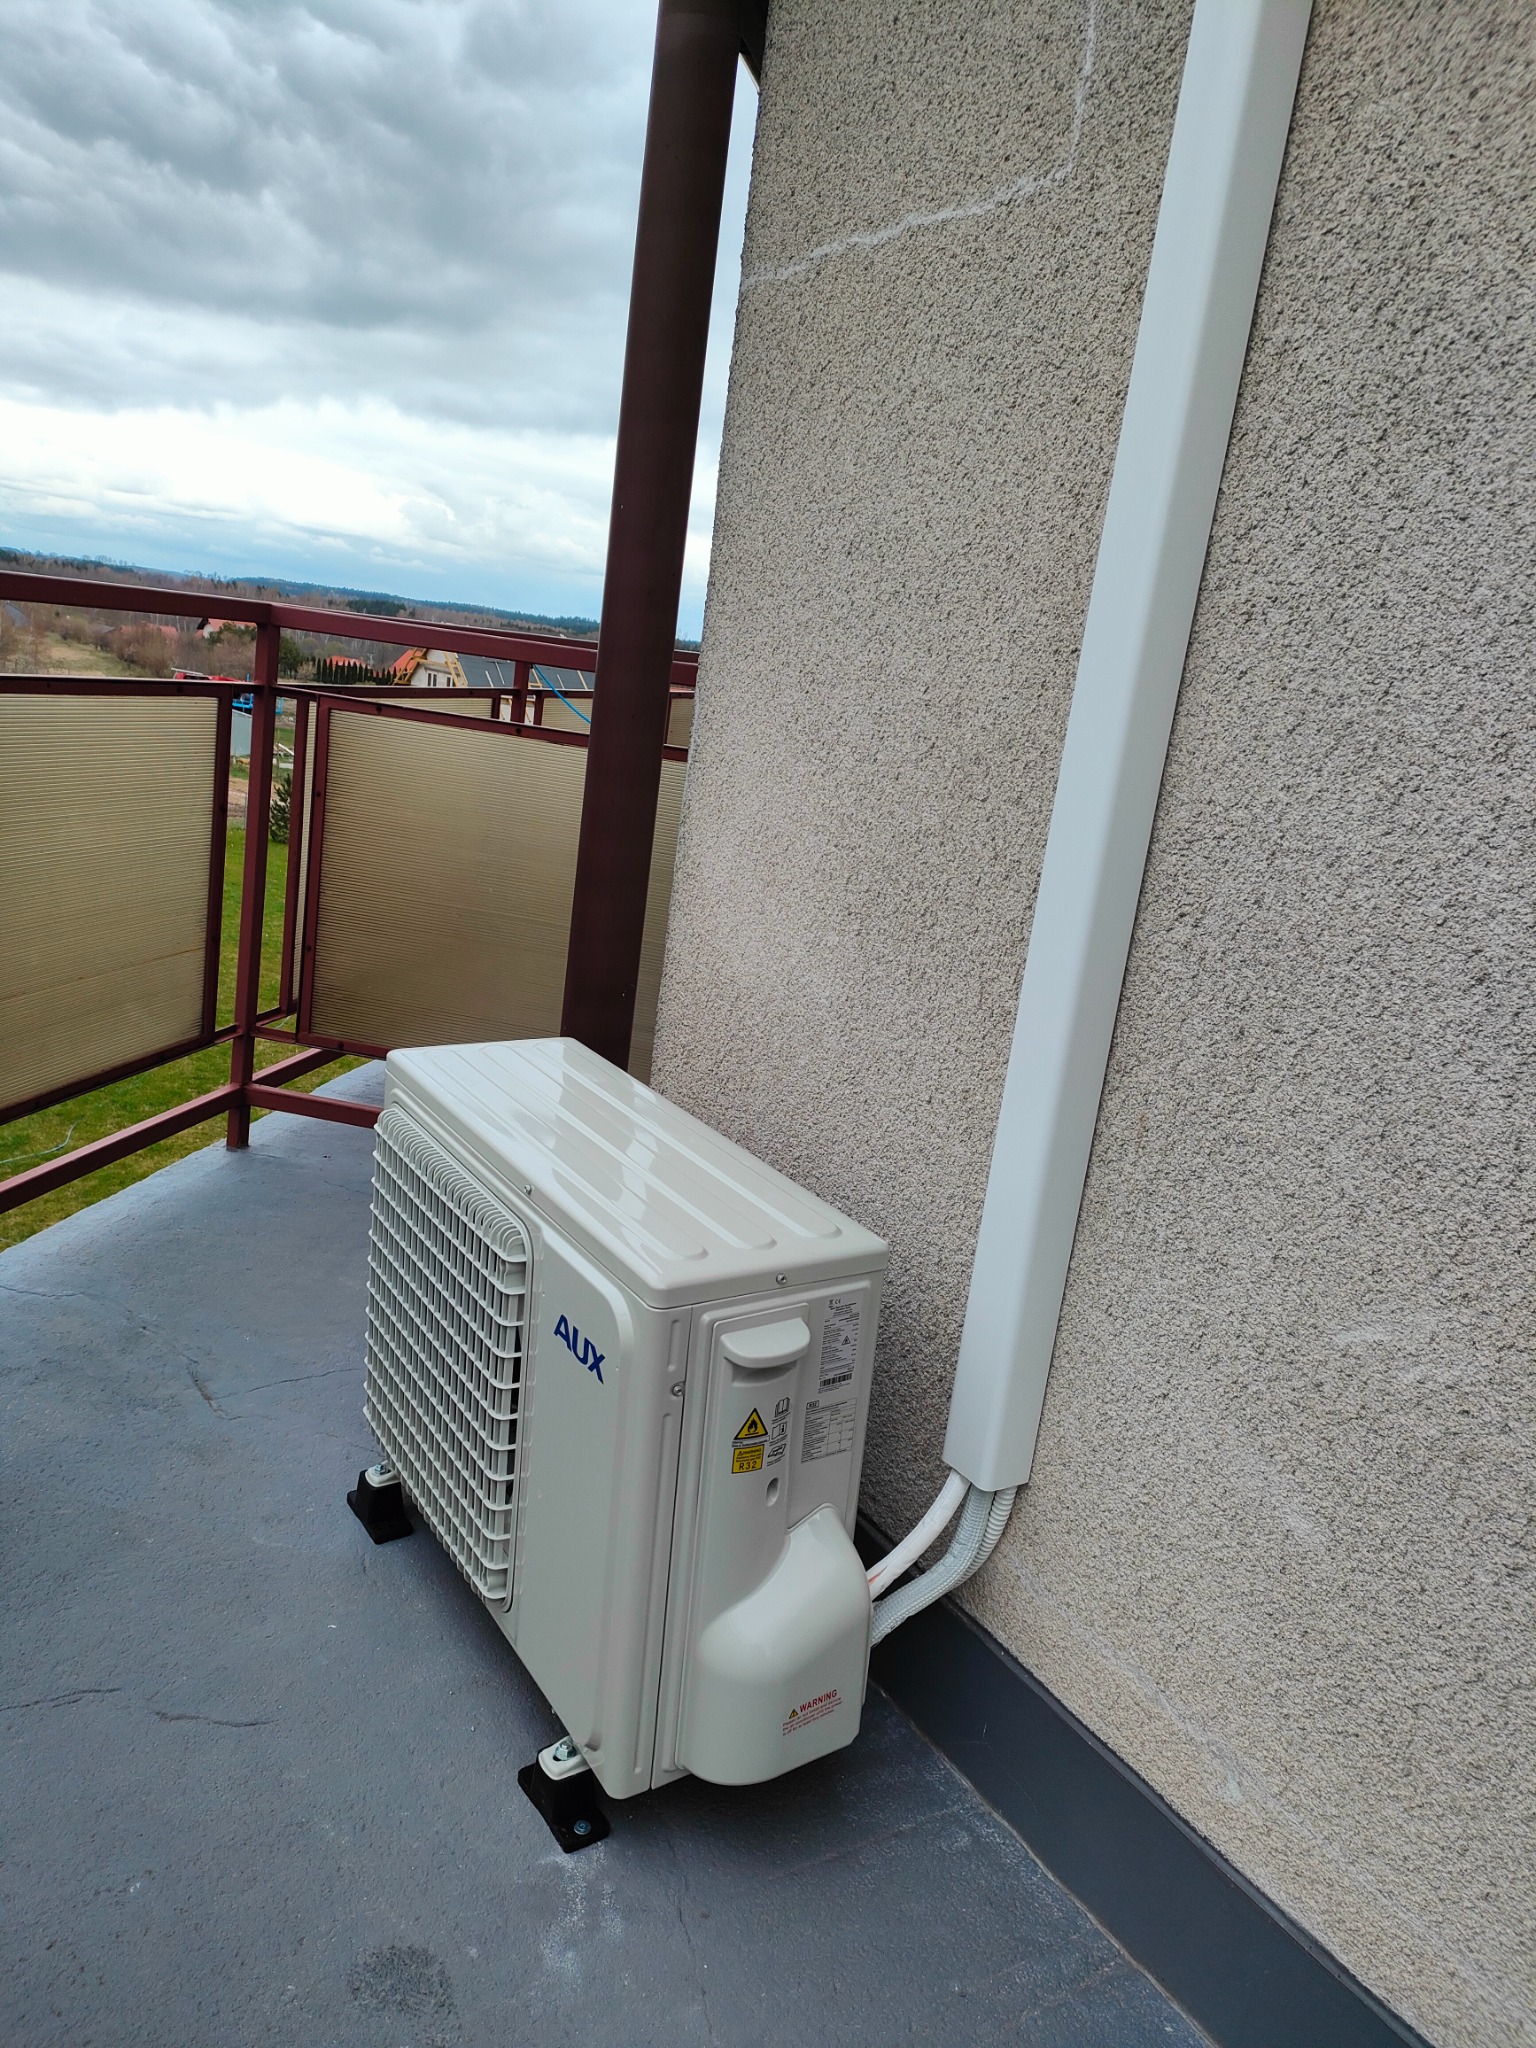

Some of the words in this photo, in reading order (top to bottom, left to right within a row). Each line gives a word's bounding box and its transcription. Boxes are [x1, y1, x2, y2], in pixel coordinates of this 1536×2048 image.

[553, 1314, 606, 1385] AUX
[738, 1460, 757, 1471] R32
[799, 1689, 837, 1712] WARNING
